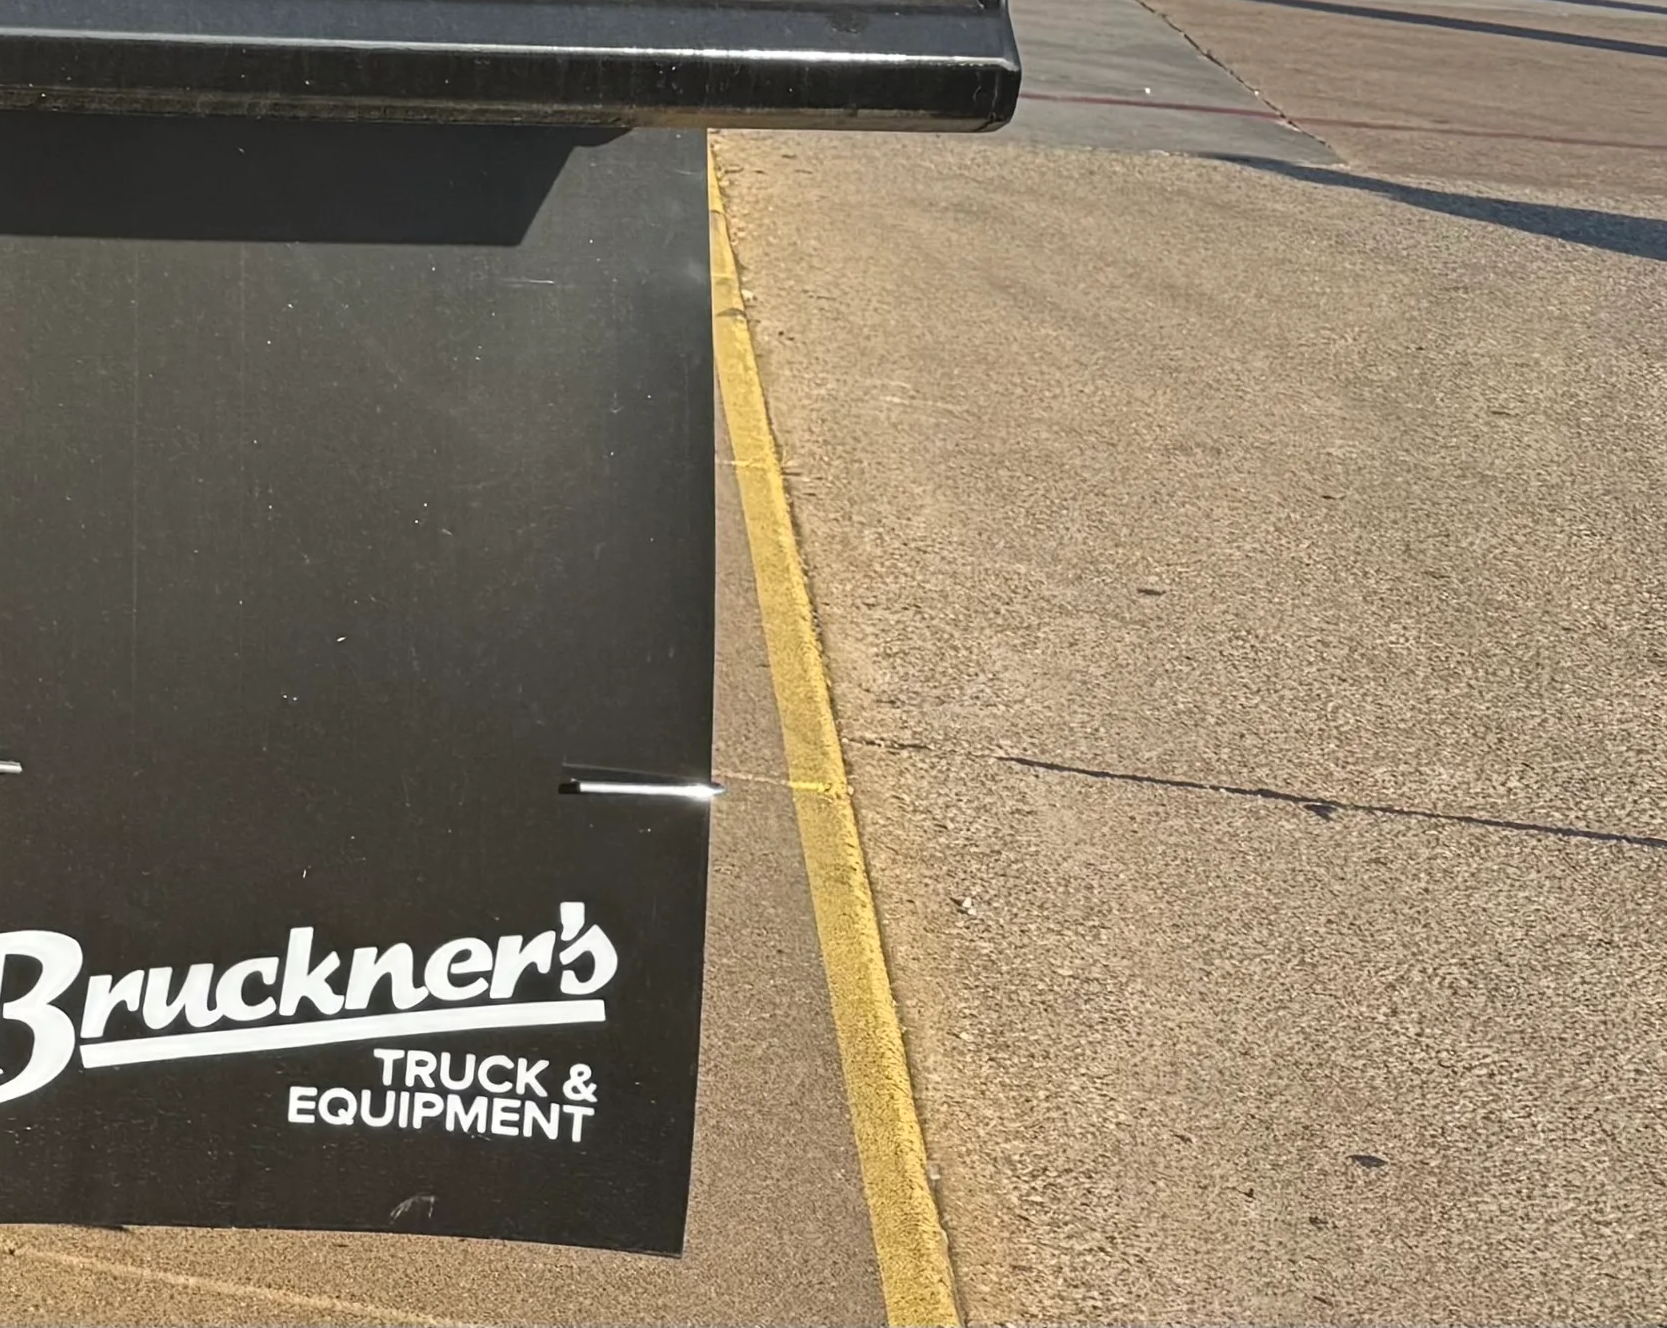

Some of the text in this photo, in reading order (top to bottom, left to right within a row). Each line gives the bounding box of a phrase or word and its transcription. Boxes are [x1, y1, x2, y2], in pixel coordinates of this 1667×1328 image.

[373, 1047, 598, 1103] TRUCK &
[287, 1085, 596, 1143] EQUIPMENT
